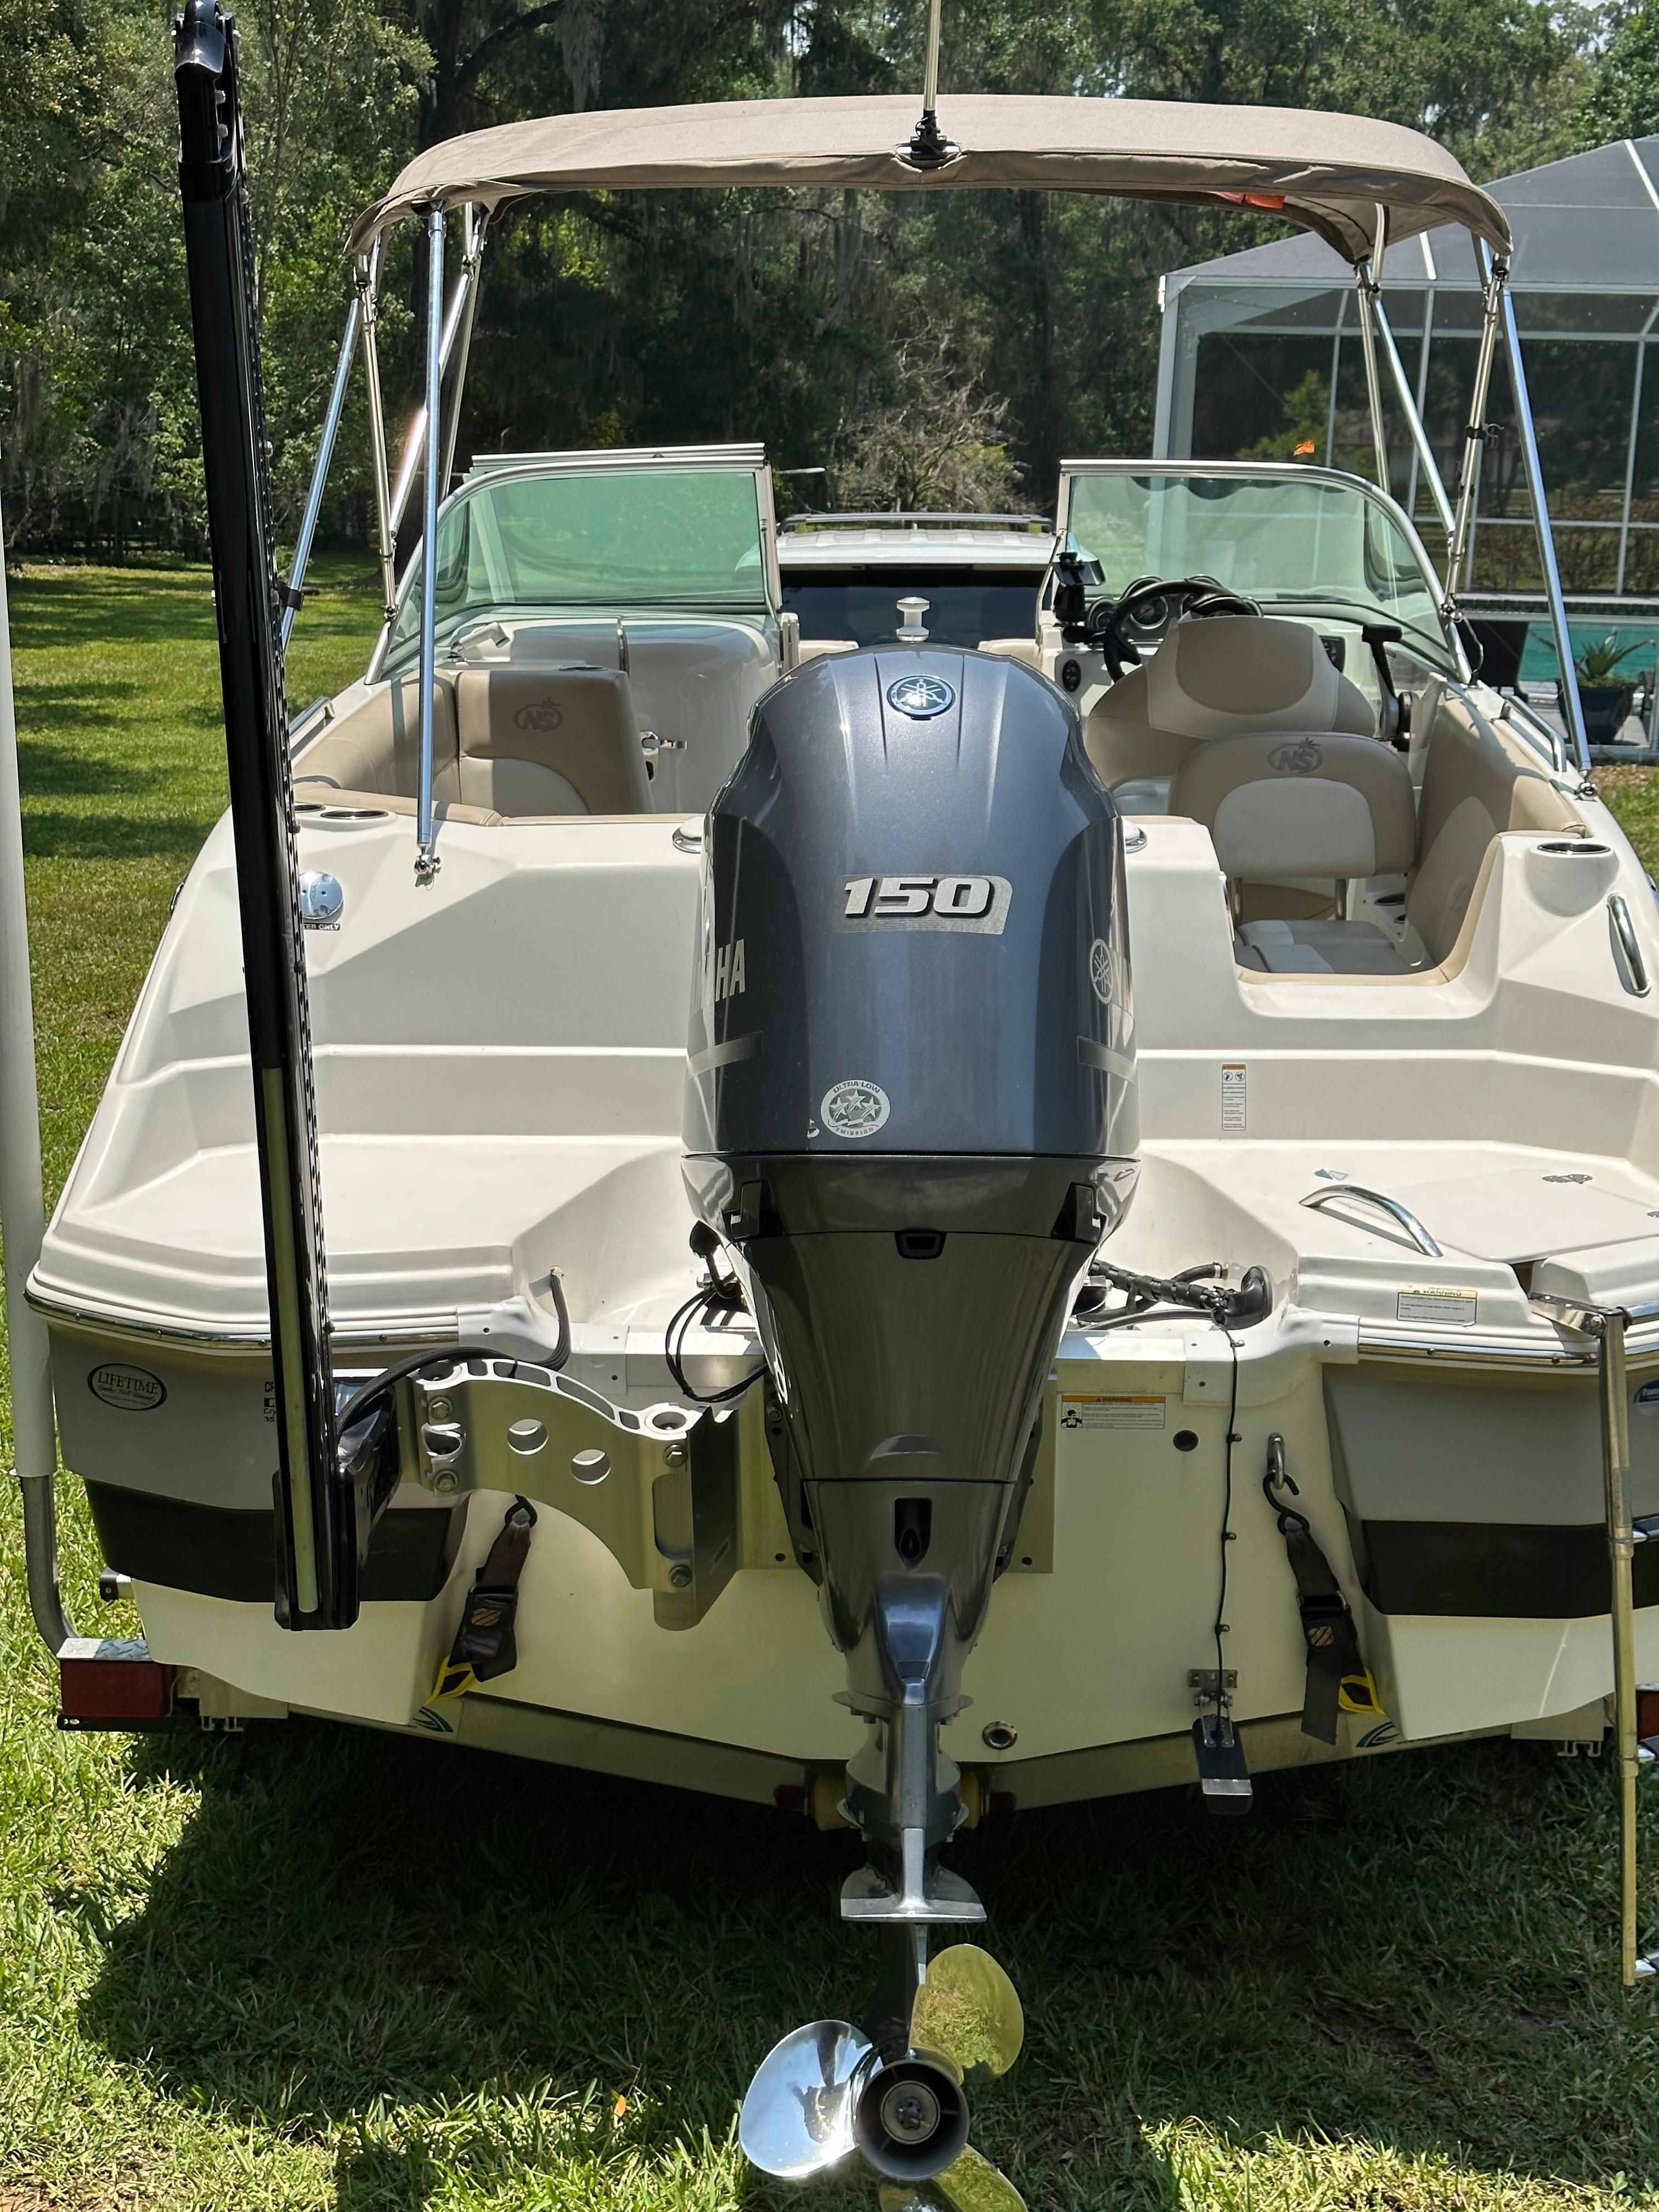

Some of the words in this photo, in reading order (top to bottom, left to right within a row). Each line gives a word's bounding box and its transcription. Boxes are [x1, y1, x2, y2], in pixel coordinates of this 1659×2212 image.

[844, 877, 991, 916] 150
[833, 1081, 859, 1093] ULTRA
[861, 1081, 881, 1093] LOW
[98, 1371, 159, 1395] LIFETIME
